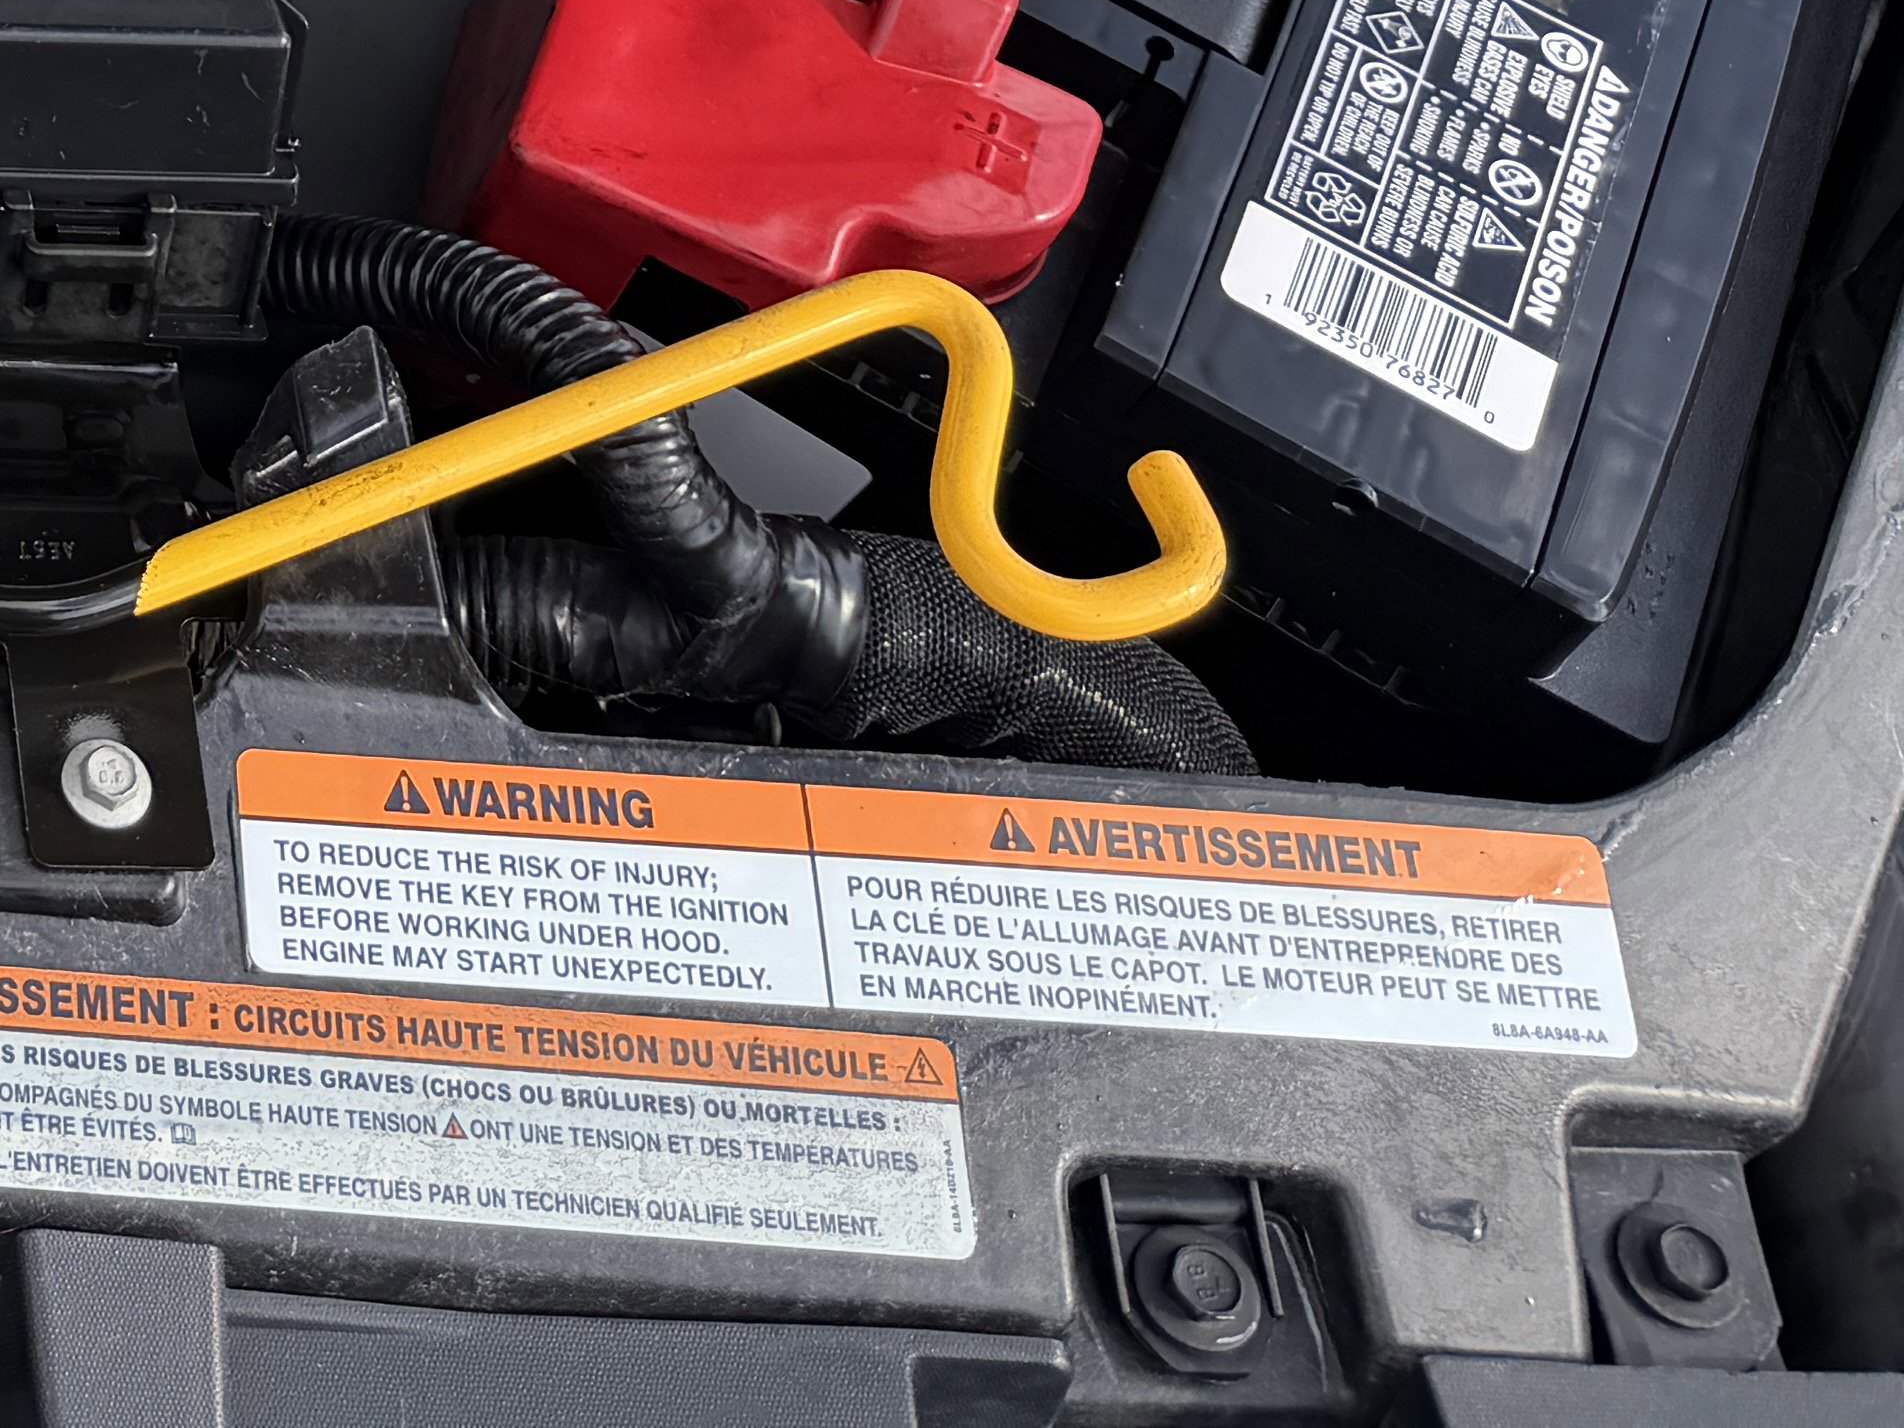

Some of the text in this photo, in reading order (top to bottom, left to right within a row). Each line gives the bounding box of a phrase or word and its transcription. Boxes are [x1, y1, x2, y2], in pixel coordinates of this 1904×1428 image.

[1477, 38, 1506, 82] GASES
[1489, 48, 1528, 119] EXPLOSIVE
[1526, 61, 1554, 100] EYES
[1544, 72, 1575, 121] SHIELD
[1496, 131, 1521, 157] NO
[1522, 87, 1619, 329] DANGER/POISON
[1432, 194, 1479, 289] SULFURIC ACID
[1301, 309, 1374, 358] 92350
[1379, 351, 1455, 403] 76827
[431, 776, 655, 829] WARNING
[272, 838, 718, 894] TO REDUCE THE RISK OF INJURY;
[1047, 815, 1421, 879] AVERTISSEMENT
[276, 871, 789, 926] REMOVE THE KEY FROM THE IGNITION
[846, 874, 1562, 944] POUR RÉDUIRE LES RISQUES DE BLESSURES, RETIRER
[279, 903, 730, 955] BEFORE WORKING UNDER HOOD.
[850, 906, 1563, 977] LA CLÉ DE L'ALLUMAGE AVANT D'ENTREPRENDRE DES
[281, 937, 772, 991] ENGINE MAY START UNEXPECTEDLY.
[852, 939, 1602, 1012] TRAVAUX SOUS LE CAPOT. LE MOTEUR PEUT SE METTRE
[858, 972, 1223, 1019] EN MARCHE INOPINÉMENT.
[232, 1002, 387, 1044] CIRCUITS
[395, 1015, 506, 1053] HAUTE
[513, 1024, 659, 1065] TENSION
[669, 1036, 714, 1069] DU
[722, 1035, 889, 1083] VÉHICULE
